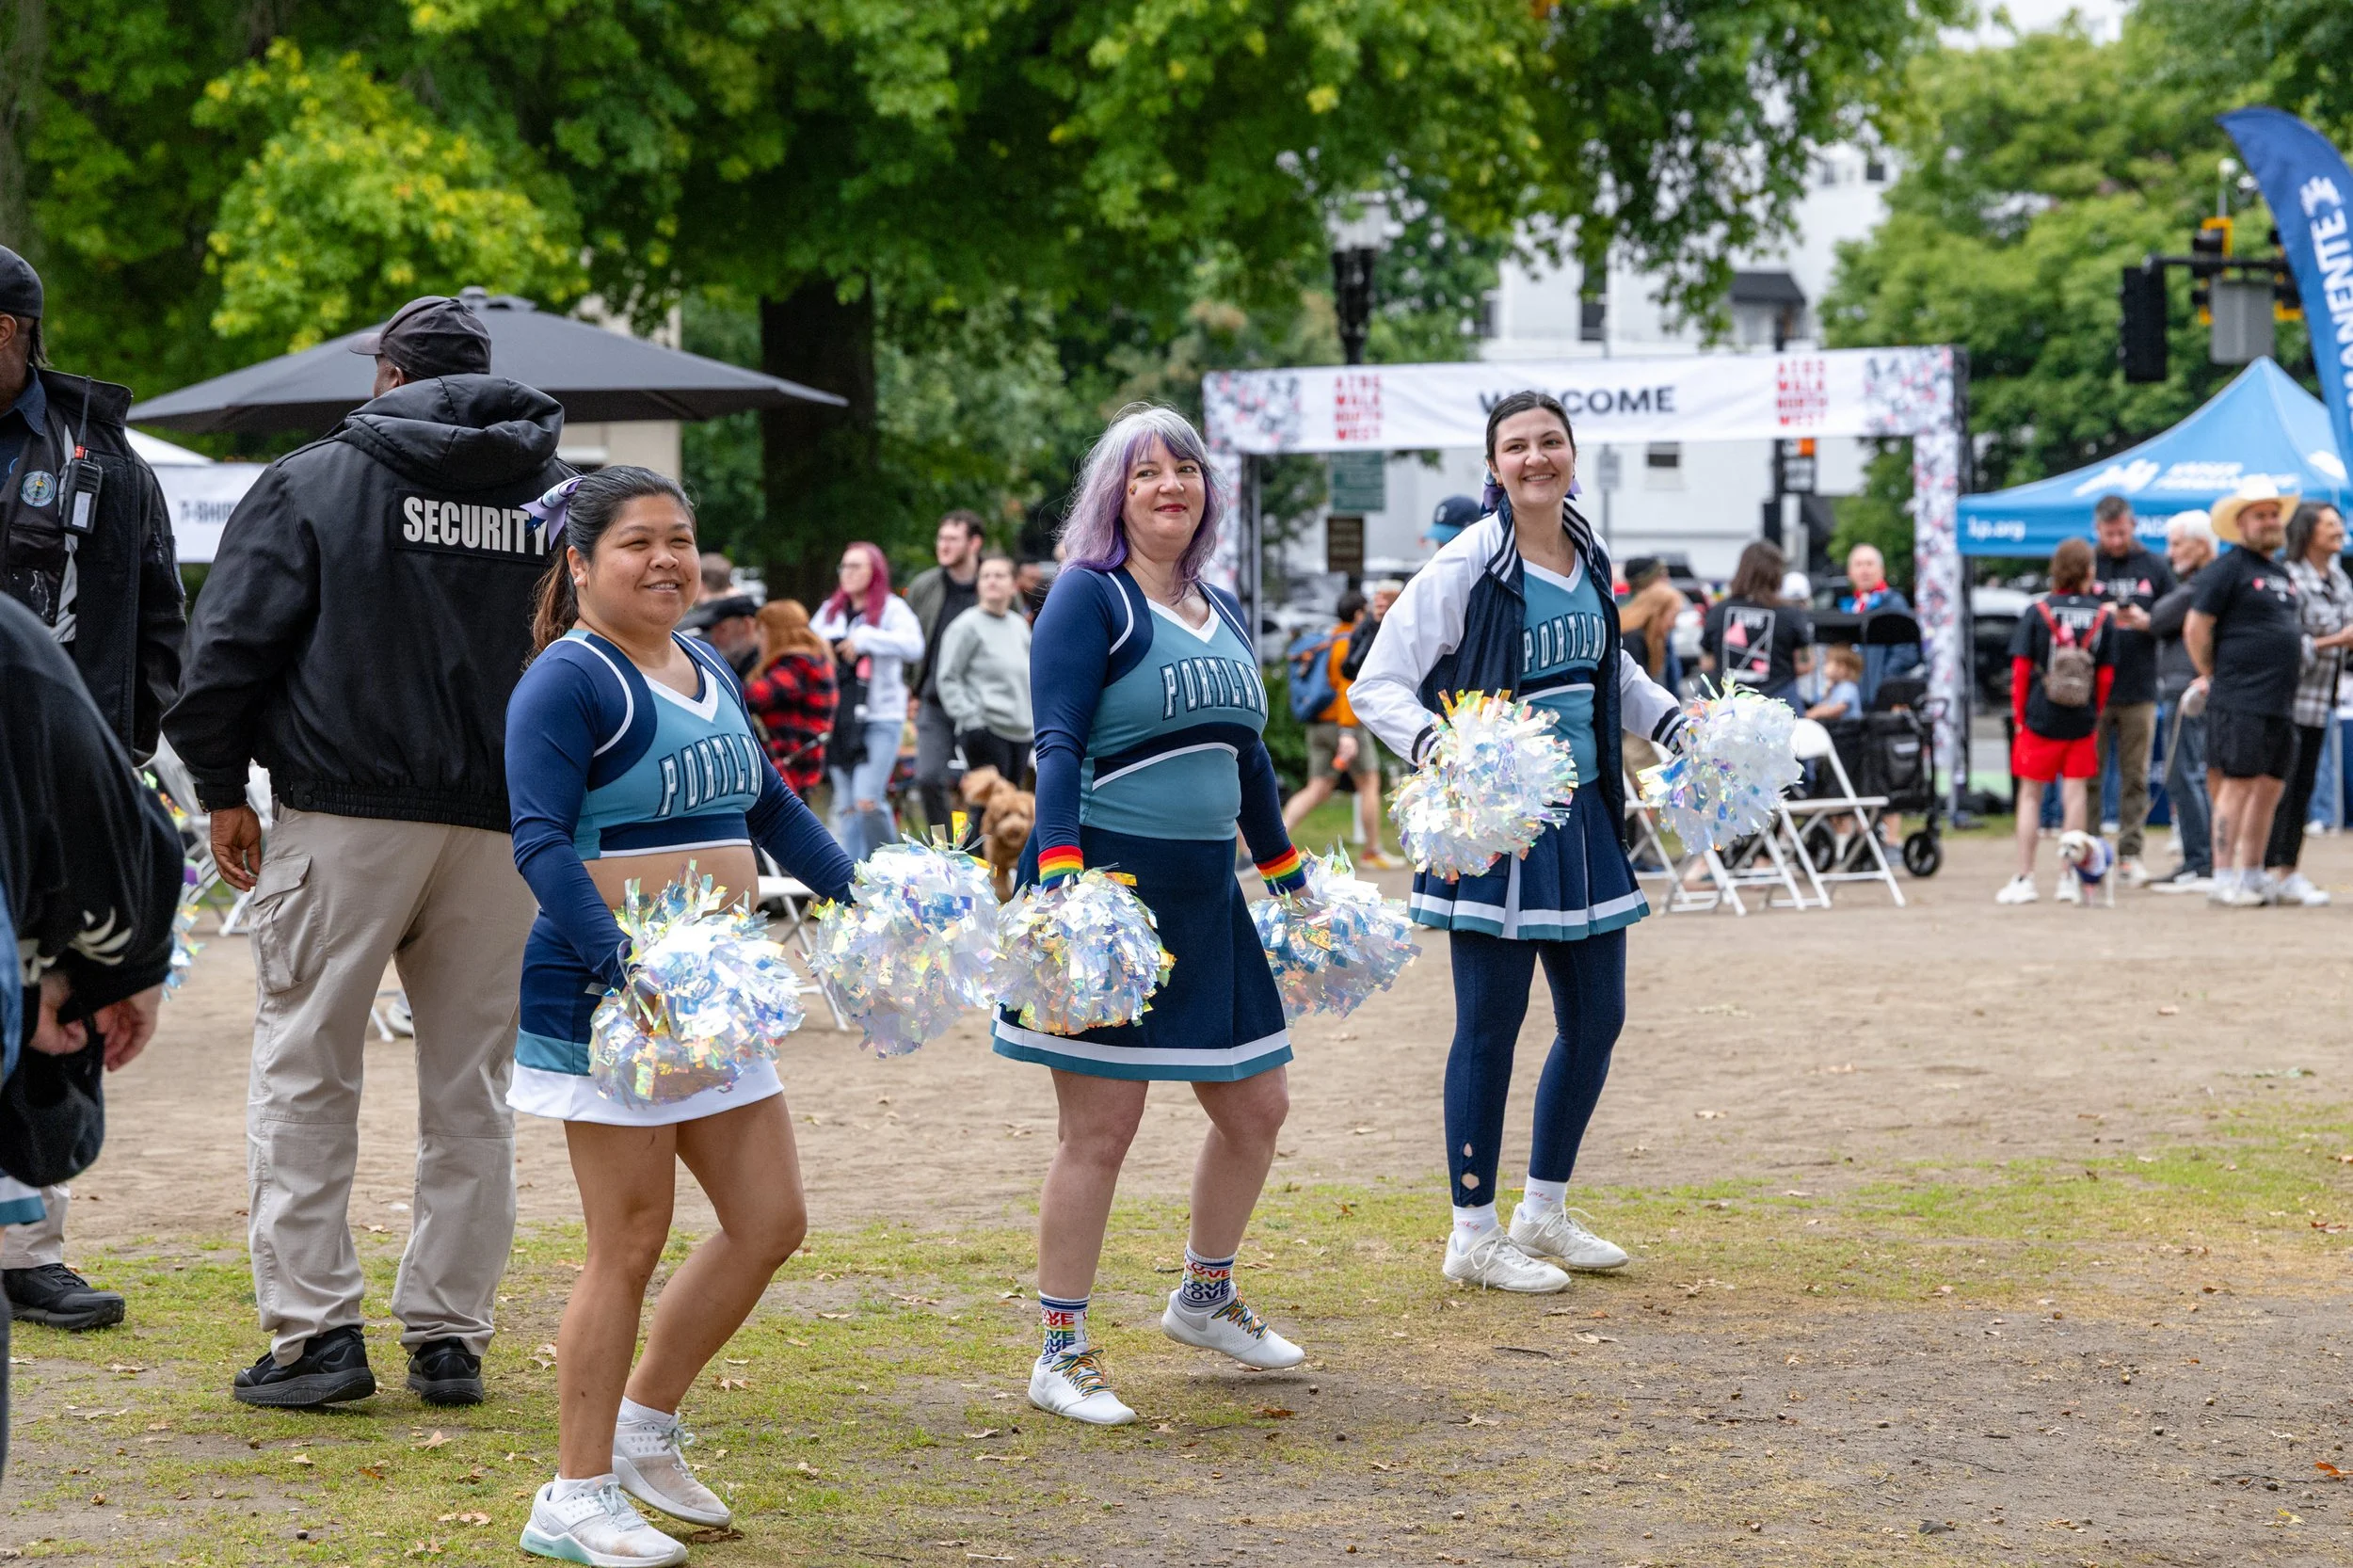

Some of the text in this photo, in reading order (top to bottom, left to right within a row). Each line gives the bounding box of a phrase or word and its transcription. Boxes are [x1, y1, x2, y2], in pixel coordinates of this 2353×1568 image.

[1478, 387, 1675, 415] WCOME
[403, 496, 548, 555] SECURITY
[654, 733, 762, 818] PORTLA
